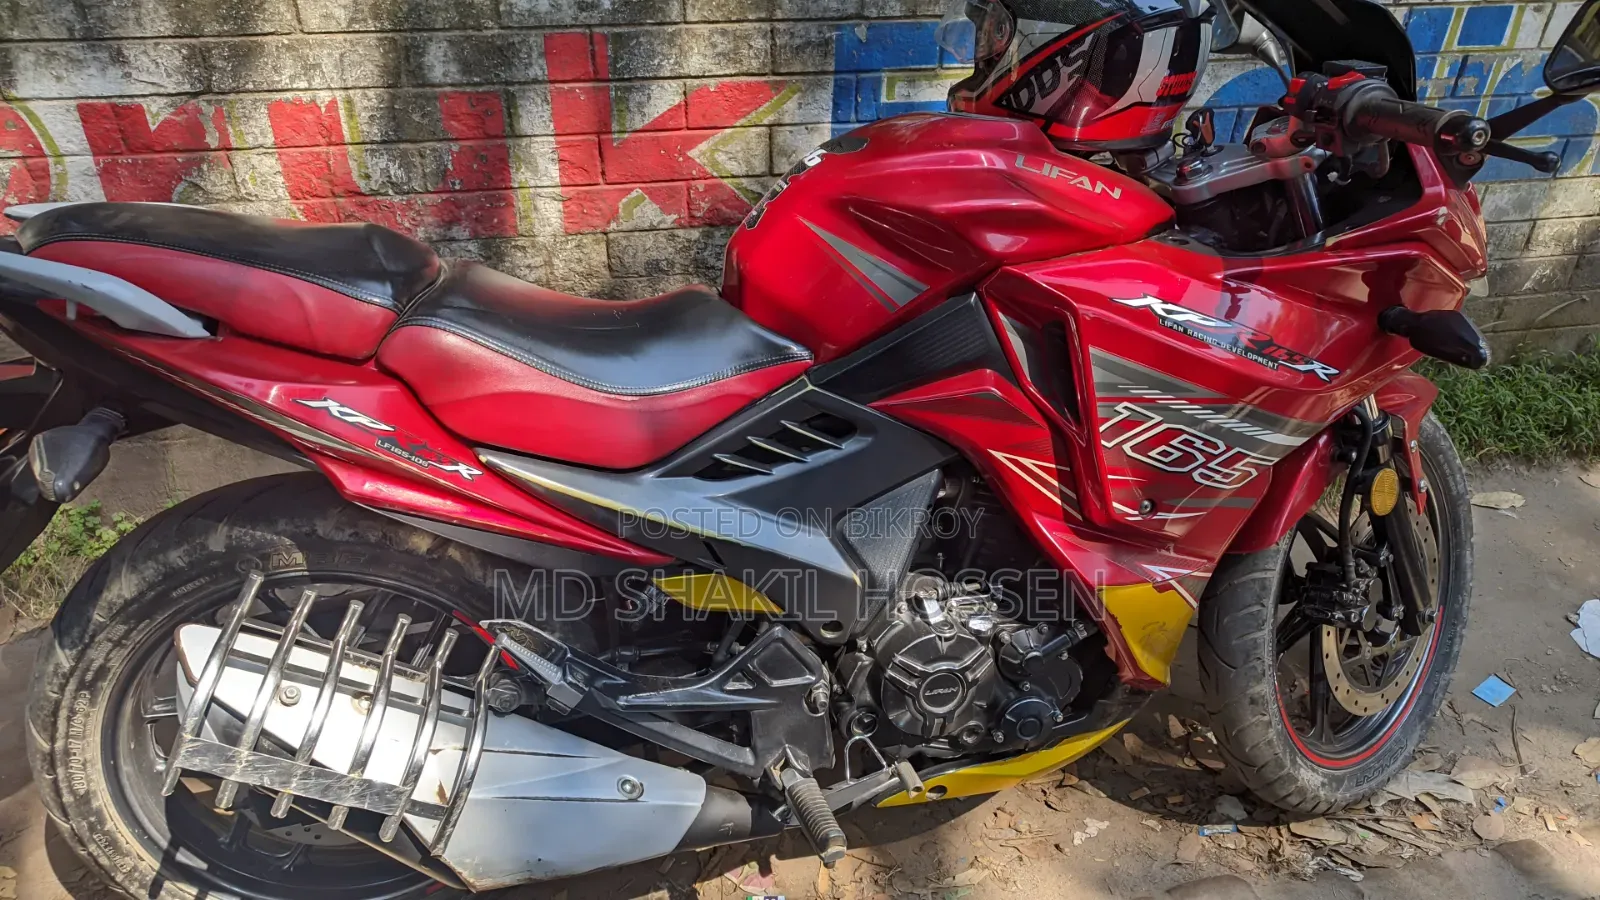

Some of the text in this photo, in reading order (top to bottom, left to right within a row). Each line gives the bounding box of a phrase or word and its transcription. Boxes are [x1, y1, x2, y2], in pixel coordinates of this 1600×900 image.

[1014, 153, 1122, 200] LIFAN
[1159, 319, 1279, 371] LIFAN RACING DEVELOPMENT
[1099, 402, 1281, 490] 165
